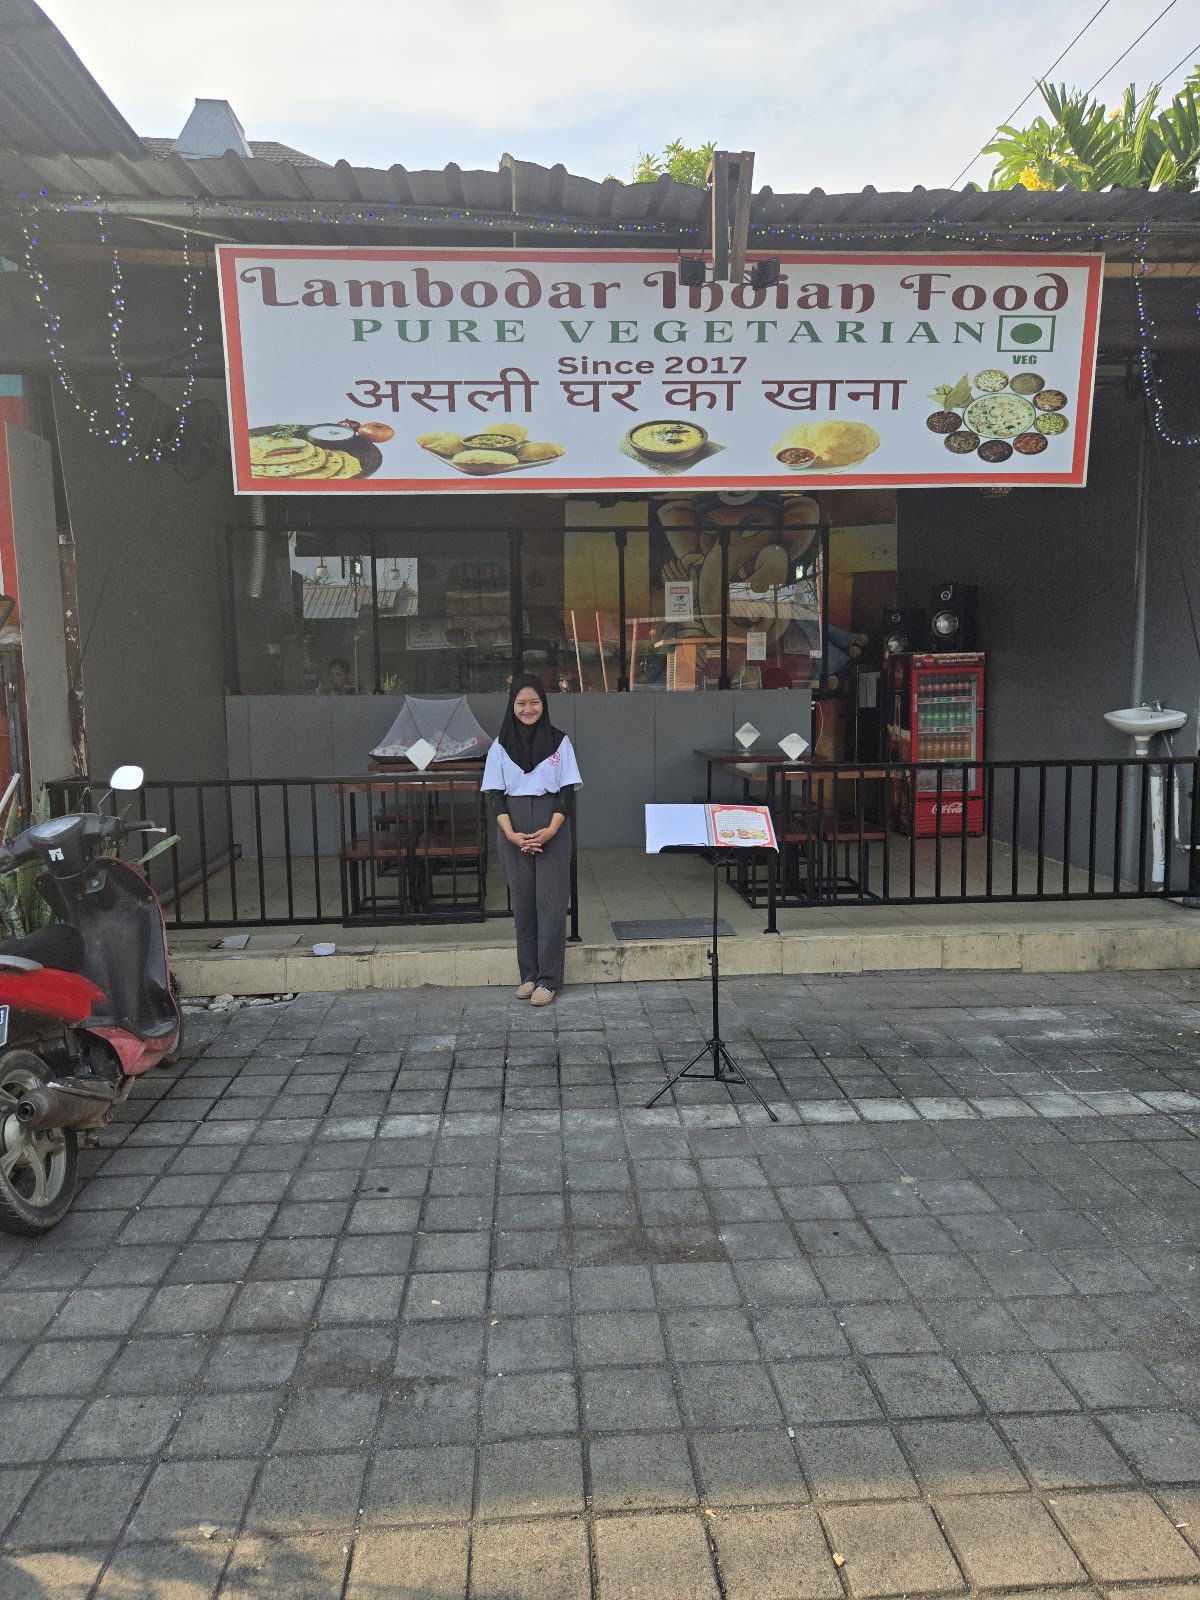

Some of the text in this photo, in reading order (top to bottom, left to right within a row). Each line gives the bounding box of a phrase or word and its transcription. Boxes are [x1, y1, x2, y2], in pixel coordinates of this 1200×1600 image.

[239, 266, 1069, 313] Lambodar Indian Food
[351, 318, 985, 343] PURE VEGETARIAN
[557, 356, 748, 375] Since 2017
[1012, 354, 1038, 365] VEG
[346, 367, 908, 413] असली घर का खाना
[931, 801, 963, 815] Cca-Col
